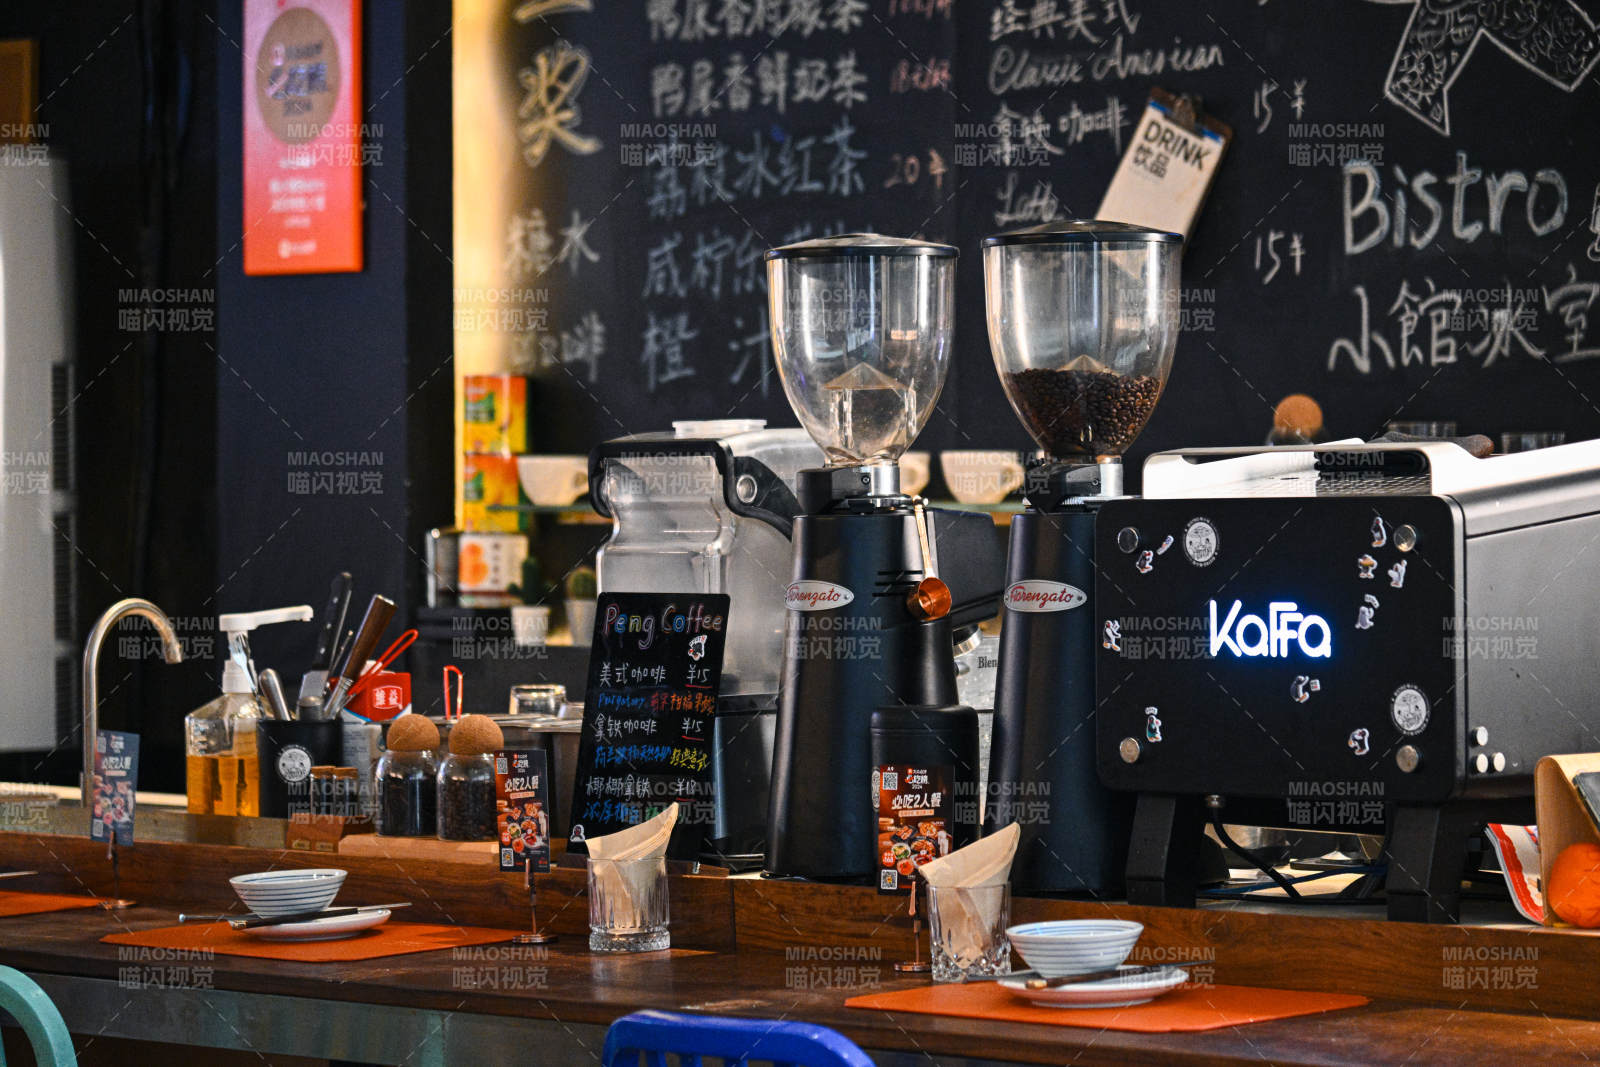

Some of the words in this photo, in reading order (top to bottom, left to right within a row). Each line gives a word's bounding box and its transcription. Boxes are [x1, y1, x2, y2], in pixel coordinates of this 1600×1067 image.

[1133, 145, 1170, 178] 饮品
[1144, 120, 1210, 171] DRINK
[1343, 151, 1568, 255] Bistro
[603, 603, 655, 650] Peng
[661, 603, 724, 635] Coffee
[599, 663, 667, 688] 美式咖啡
[595, 712, 657, 743] 拿铁咖啡
[891, 792, 942, 810] 必吃2人餐
